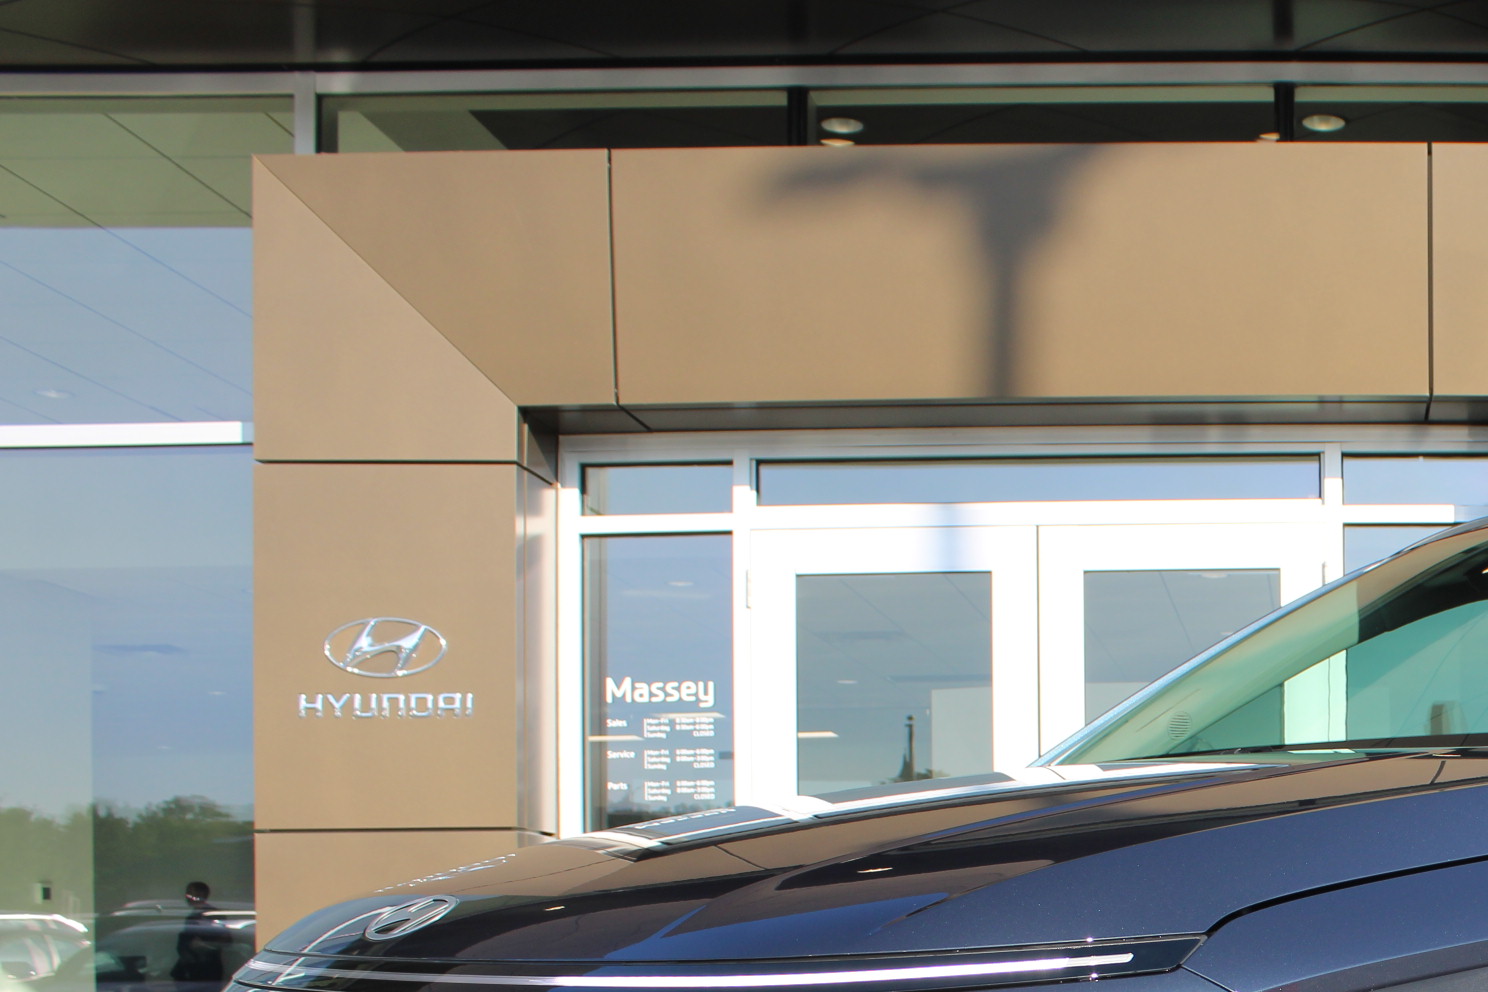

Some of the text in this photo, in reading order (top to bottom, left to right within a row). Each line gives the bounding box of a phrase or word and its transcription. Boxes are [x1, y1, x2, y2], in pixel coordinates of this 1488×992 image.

[605, 676, 715, 708] Massey
[299, 693, 473, 718] HYUNDAI
[607, 719, 627, 727] Sales
[607, 750, 635, 759] Service
[608, 782, 628, 790] Parts
